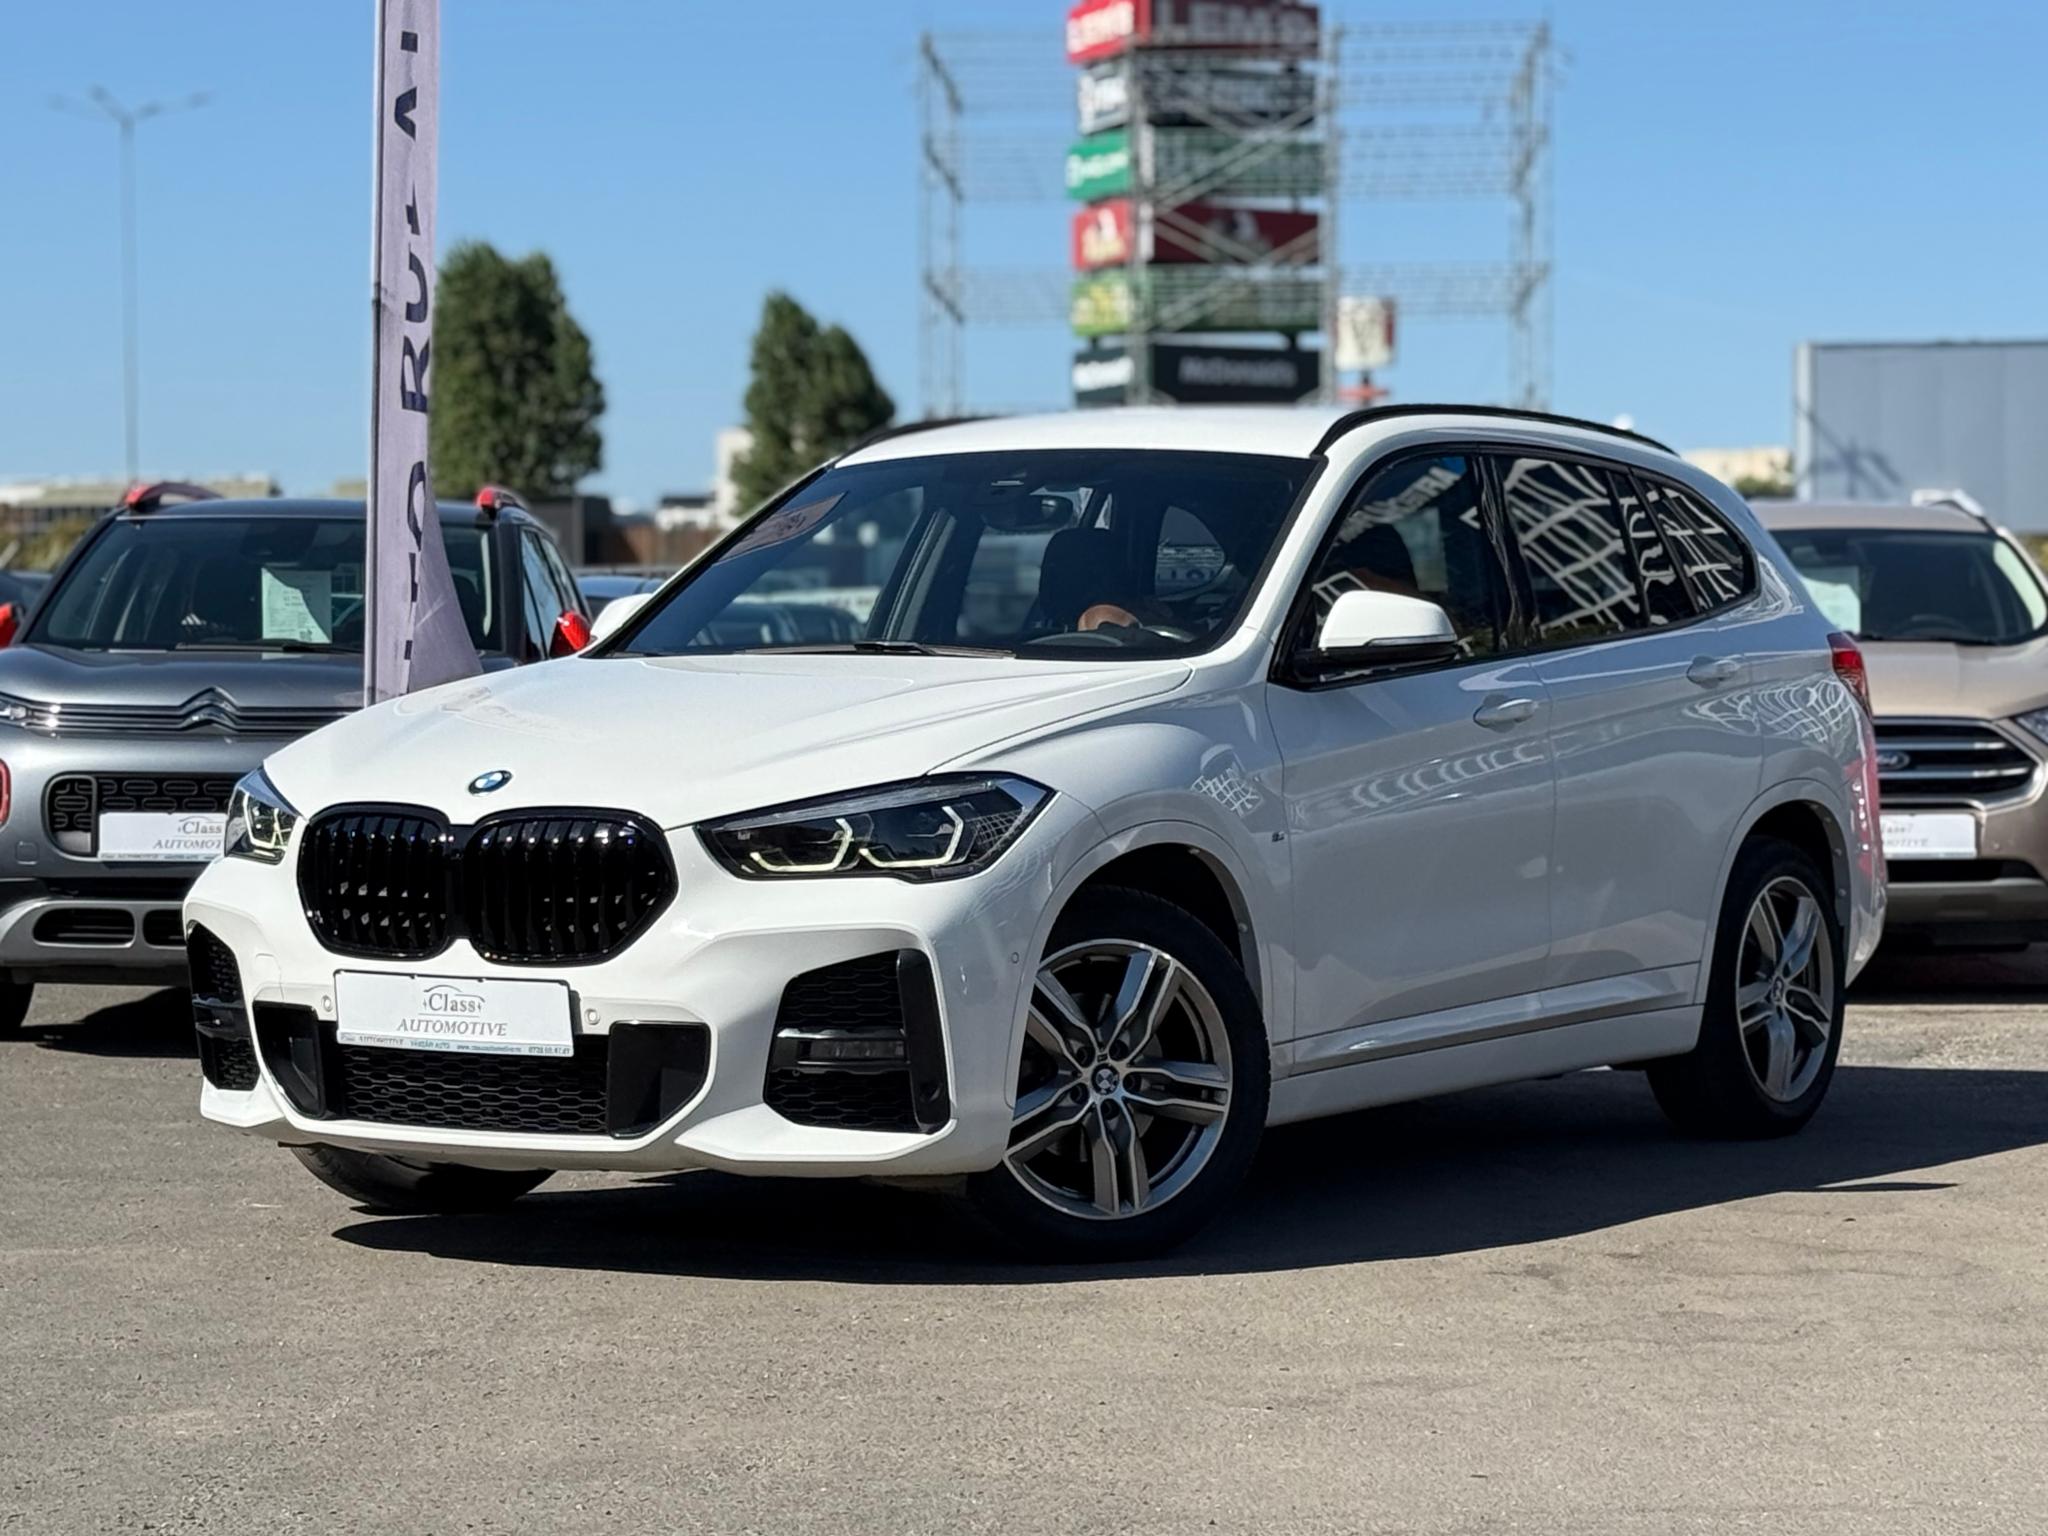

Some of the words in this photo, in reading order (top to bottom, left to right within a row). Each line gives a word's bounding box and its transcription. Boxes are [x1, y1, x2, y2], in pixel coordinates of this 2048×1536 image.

[182, 821, 222, 834] Class
[428, 993, 476, 1012] Class
[396, 1018, 508, 1036] AUTOMOTIVE
